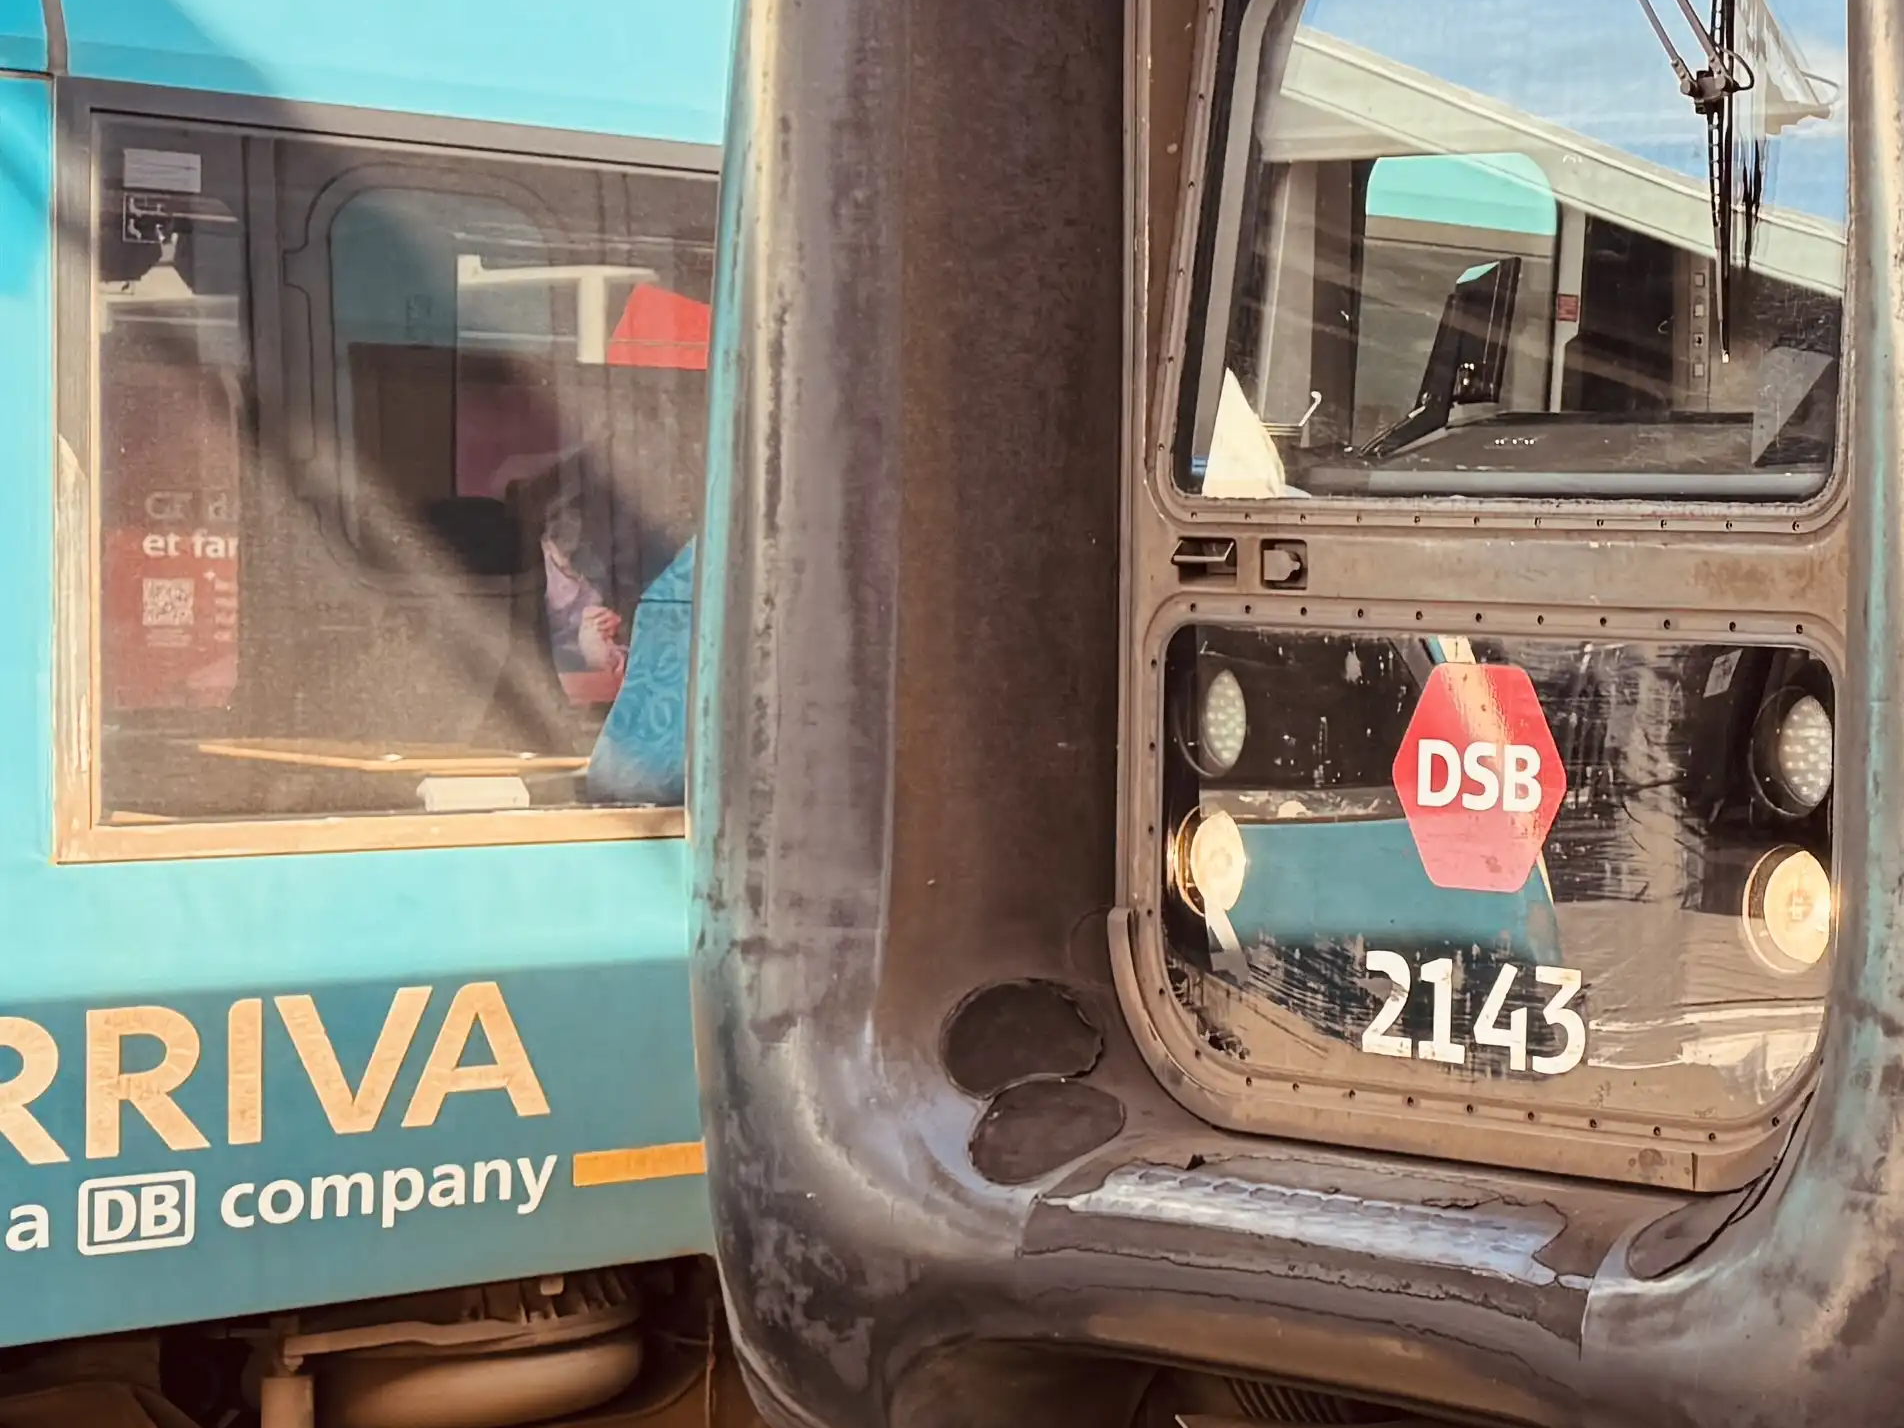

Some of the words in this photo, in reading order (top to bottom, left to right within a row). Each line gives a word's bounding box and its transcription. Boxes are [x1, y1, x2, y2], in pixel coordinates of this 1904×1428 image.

[142, 531, 180, 558] et
[1416, 738, 1543, 813] DSB
[1360, 949, 1588, 1075] 2143
[5, 1204, 49, 1252] a
[88, 1179, 187, 1246] DB
[220, 1153, 558, 1228] company
